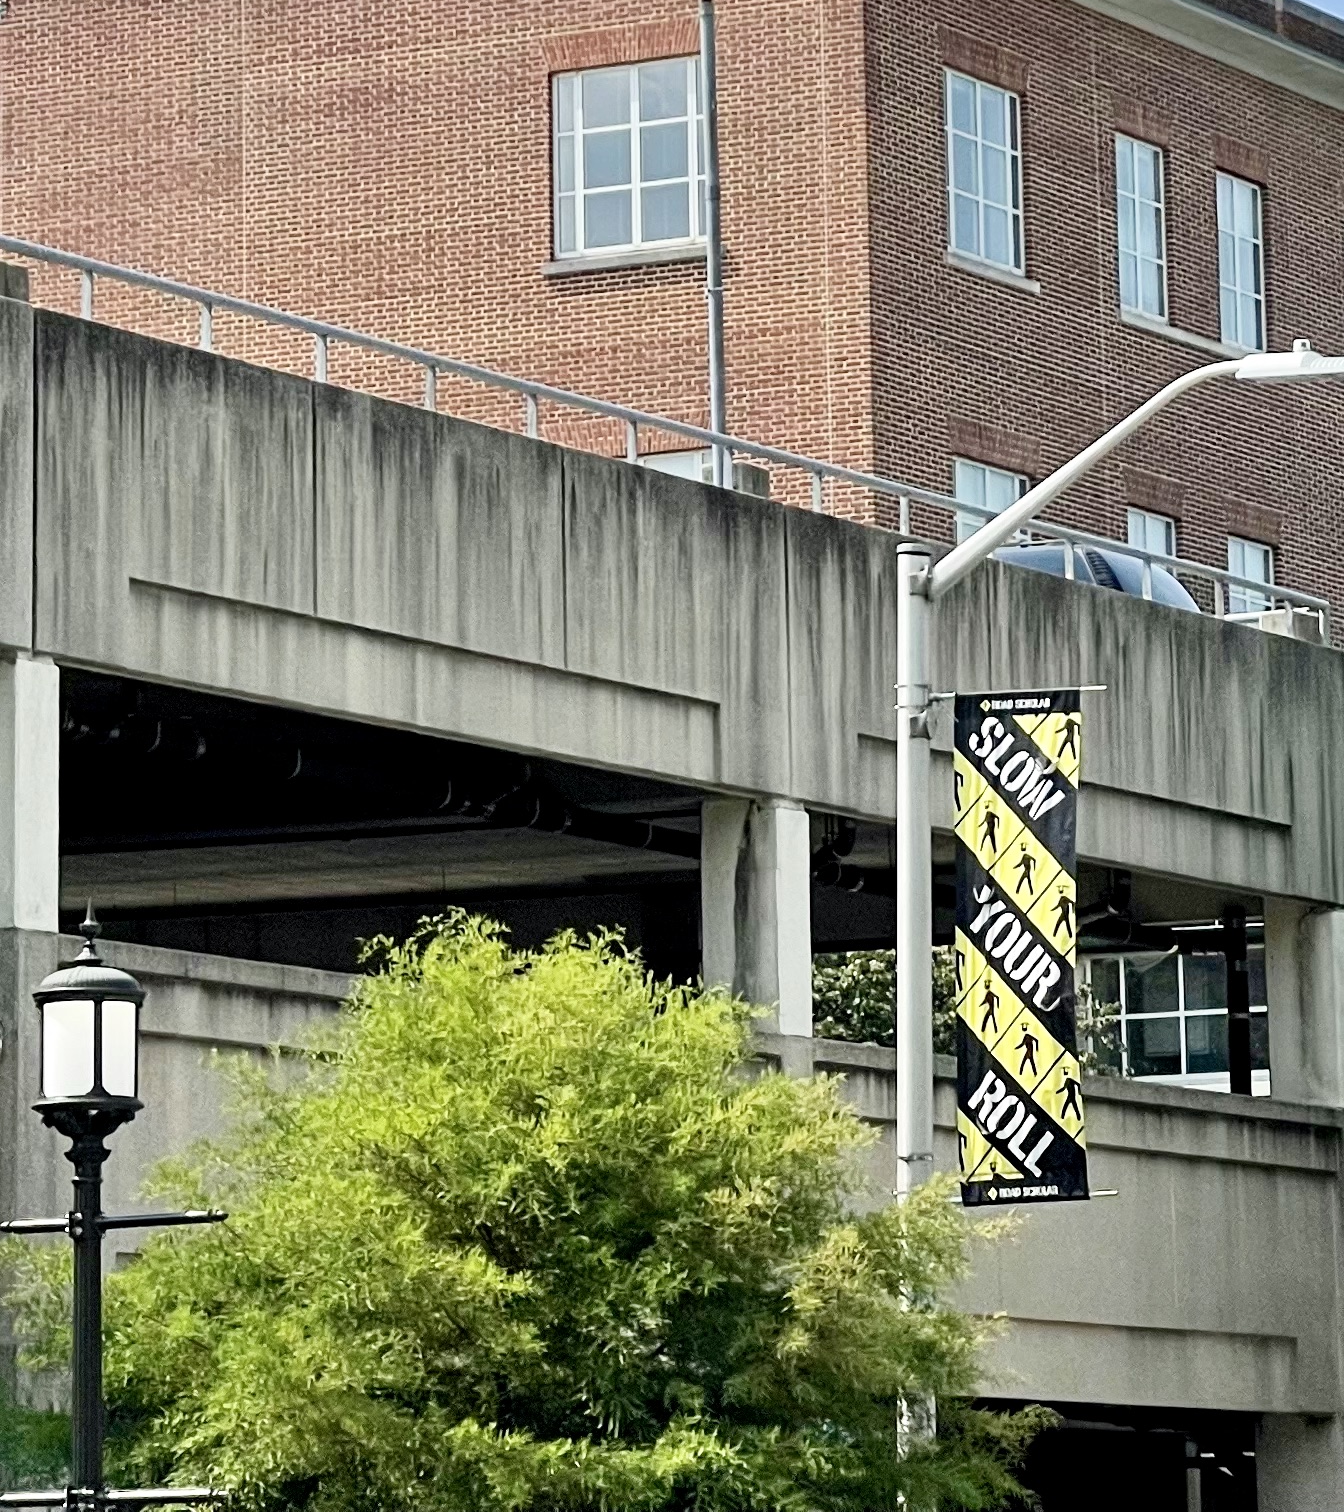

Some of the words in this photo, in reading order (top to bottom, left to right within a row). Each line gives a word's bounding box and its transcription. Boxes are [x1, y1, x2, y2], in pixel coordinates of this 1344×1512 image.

[968, 716, 1065, 821] SLOW
[969, 884, 1061, 1012] YOUR
[967, 1069, 1055, 1178] ROLL
